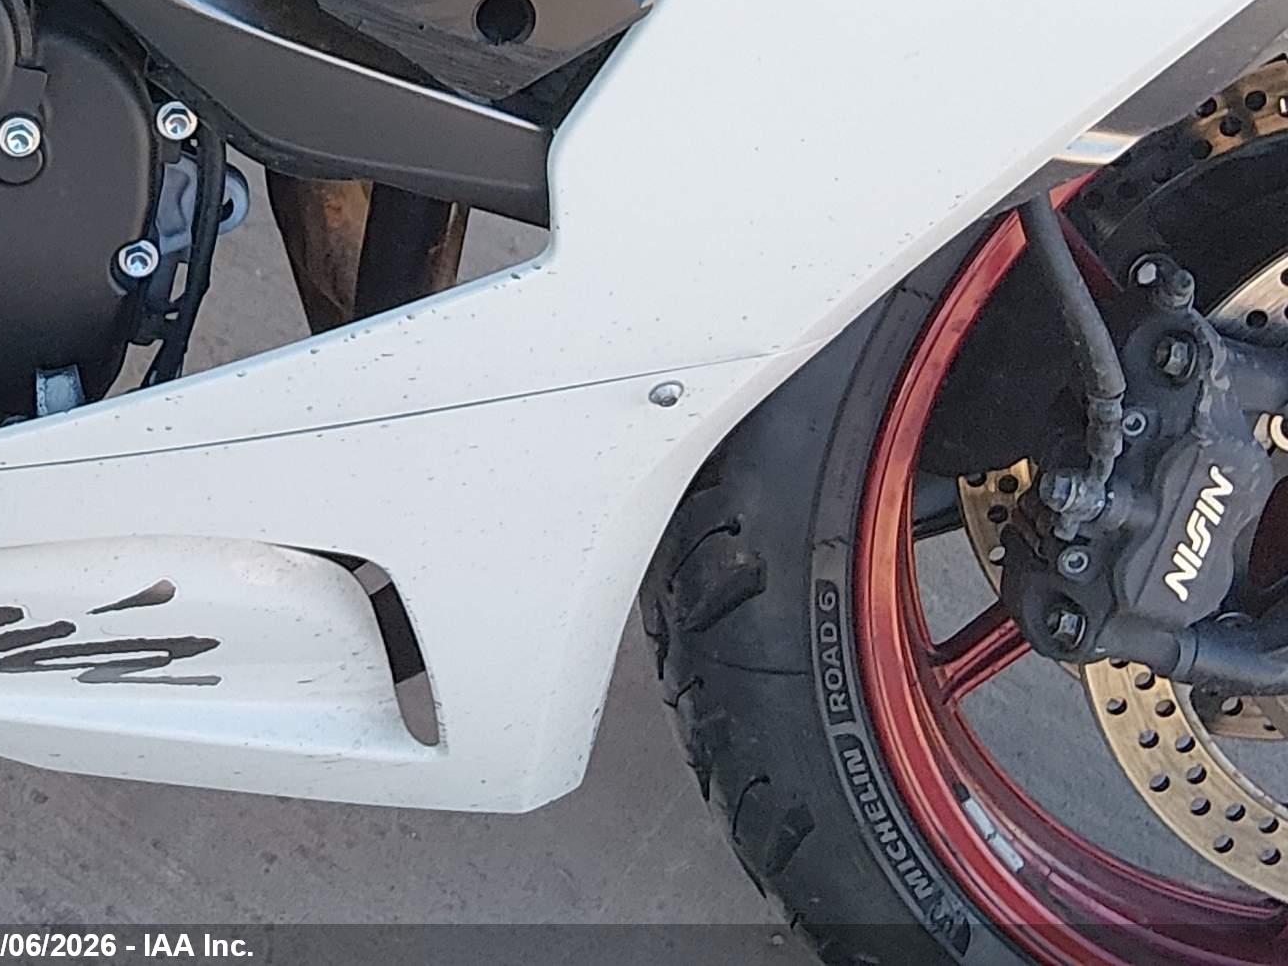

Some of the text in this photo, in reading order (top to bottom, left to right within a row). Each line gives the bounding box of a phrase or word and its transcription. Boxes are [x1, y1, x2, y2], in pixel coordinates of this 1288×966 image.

[1165, 466, 1234, 602] NISSIN
[818, 590, 934, 900] MICHELIN ROAD 6
